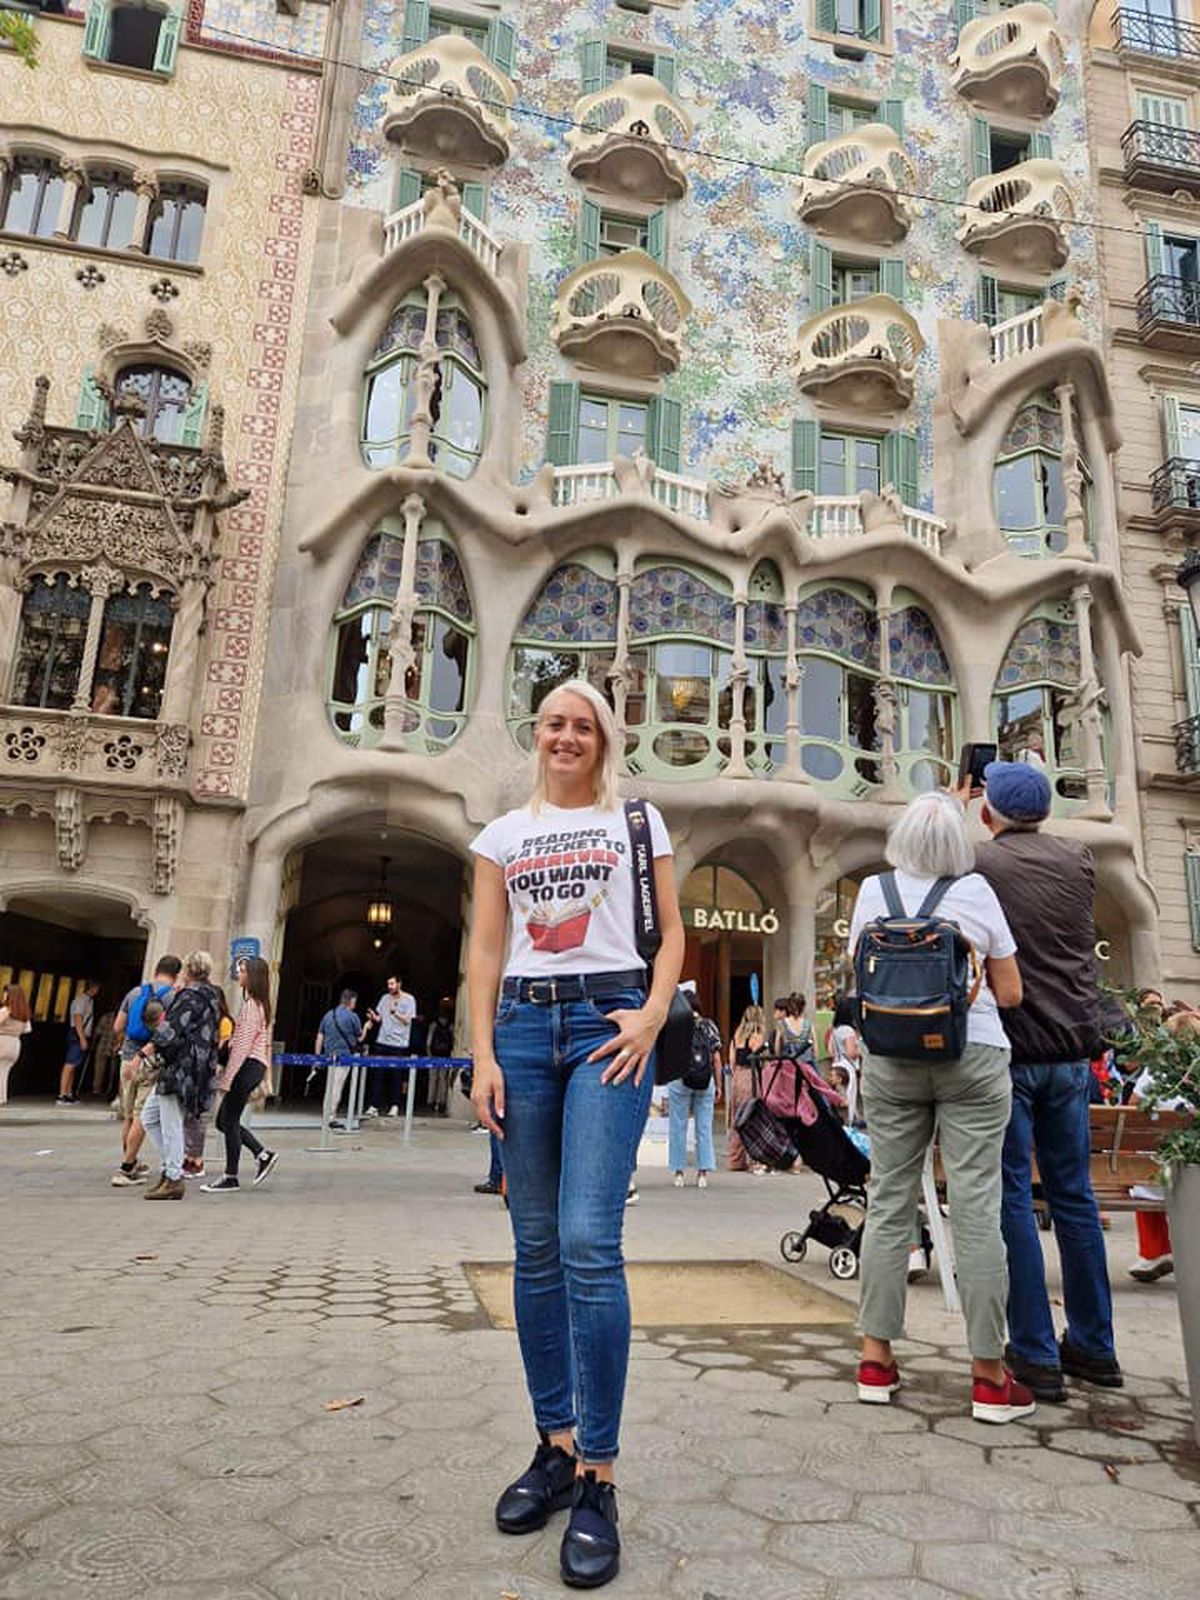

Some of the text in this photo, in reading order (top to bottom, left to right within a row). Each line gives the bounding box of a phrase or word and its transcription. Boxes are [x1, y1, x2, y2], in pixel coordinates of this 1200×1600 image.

[522, 829, 607, 849] READING
[535, 838, 601, 855] TICKET
[603, 839, 626, 854] TO
[509, 864, 613, 893] YOU WANT
[529, 882, 585, 903] TO GO
[694, 908, 779, 934] BATLLÓ
